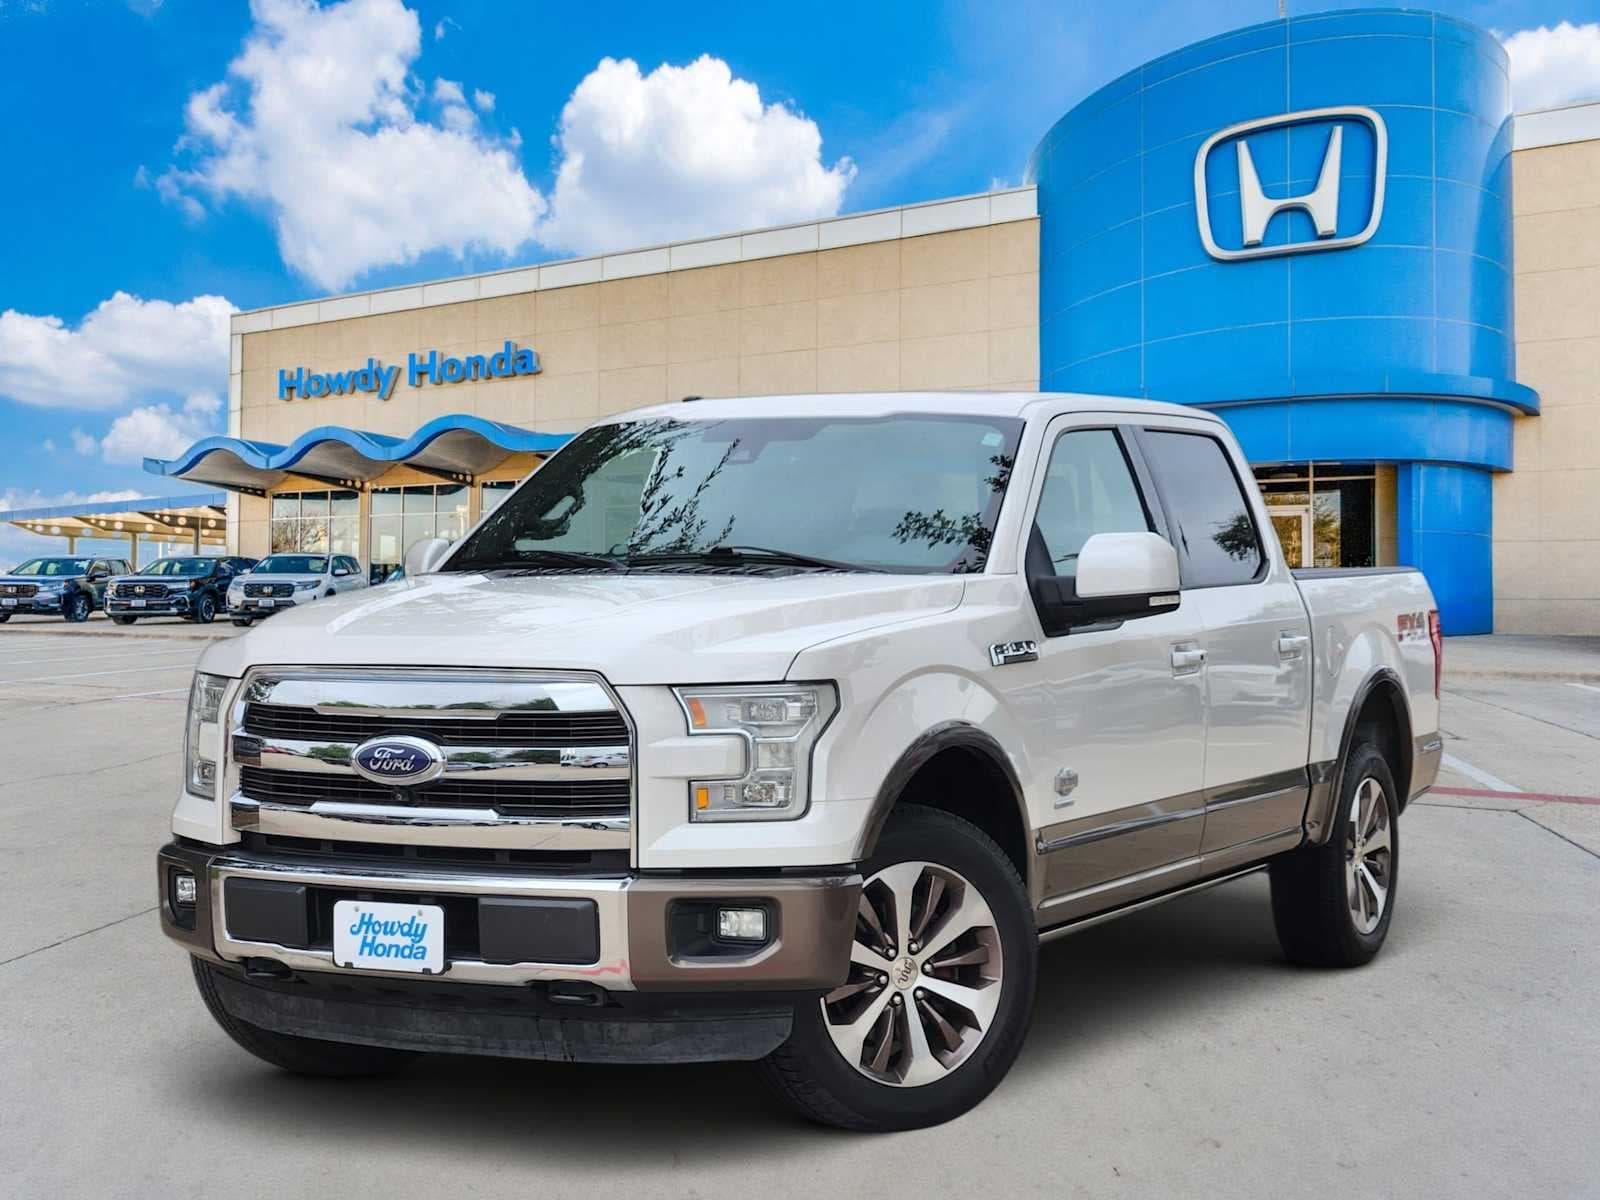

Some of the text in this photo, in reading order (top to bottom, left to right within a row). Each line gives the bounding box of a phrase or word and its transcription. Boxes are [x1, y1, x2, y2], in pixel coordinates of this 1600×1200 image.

[278, 341, 541, 400] Howdy Honda
[369, 747, 416, 771] Ford
[350, 912, 428, 944] Howdy
[358, 935, 427, 960] Honda
